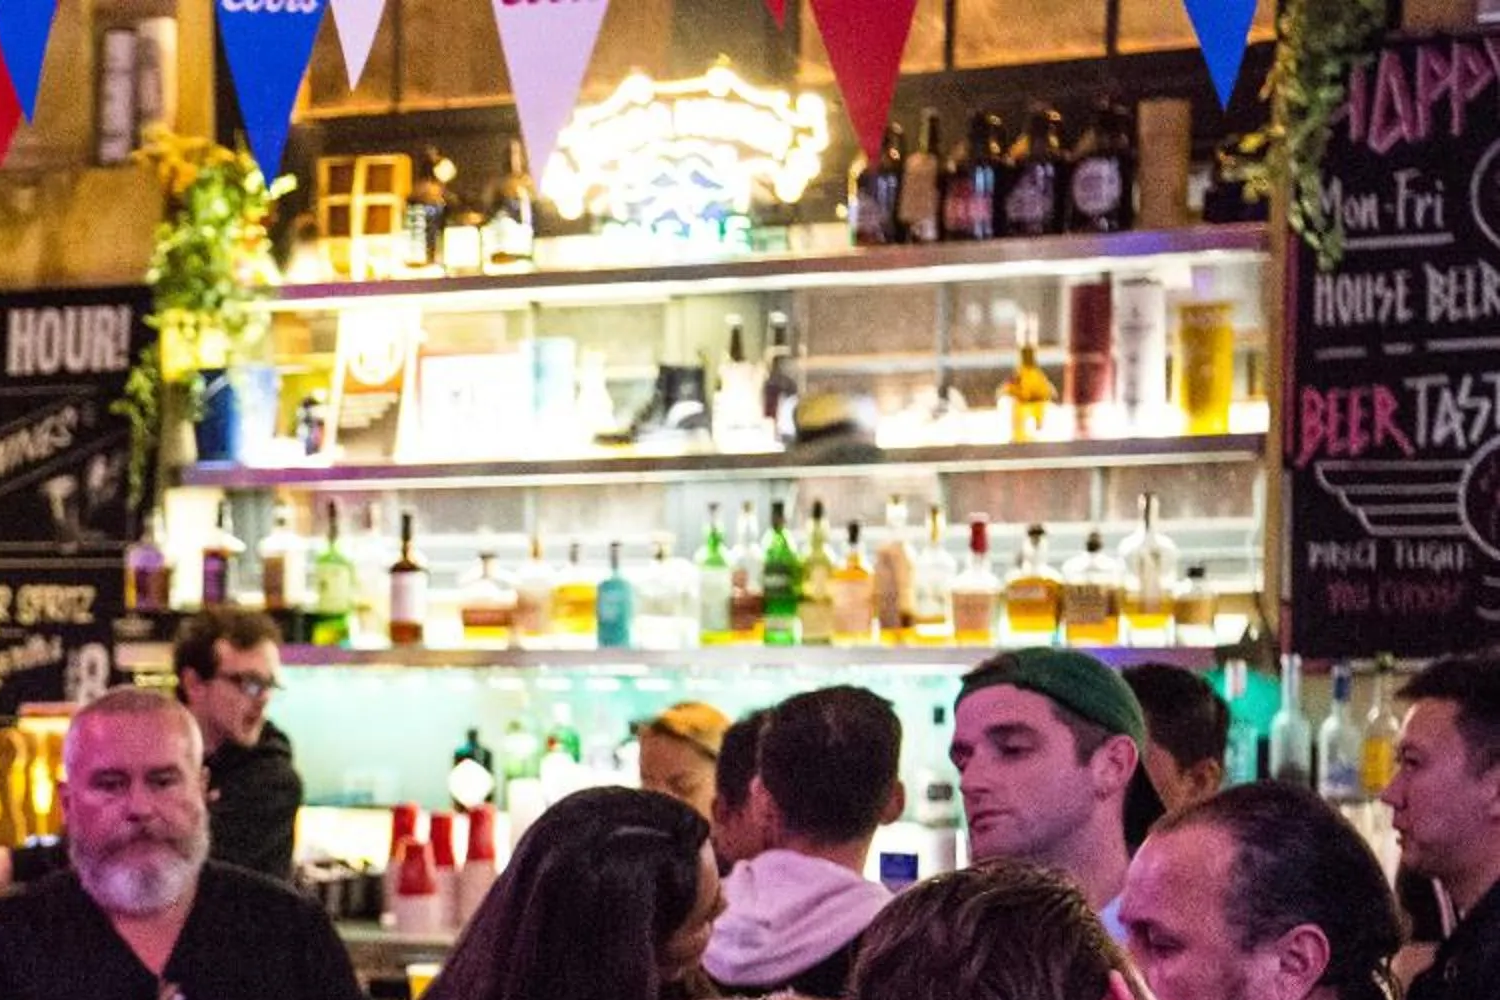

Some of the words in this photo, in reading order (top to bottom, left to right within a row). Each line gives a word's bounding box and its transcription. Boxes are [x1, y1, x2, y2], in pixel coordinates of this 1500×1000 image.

[1313, 271, 1413, 327] HOUSE
[6, 304, 132, 377] HOUR!
[1296, 383, 1415, 470] BEER
